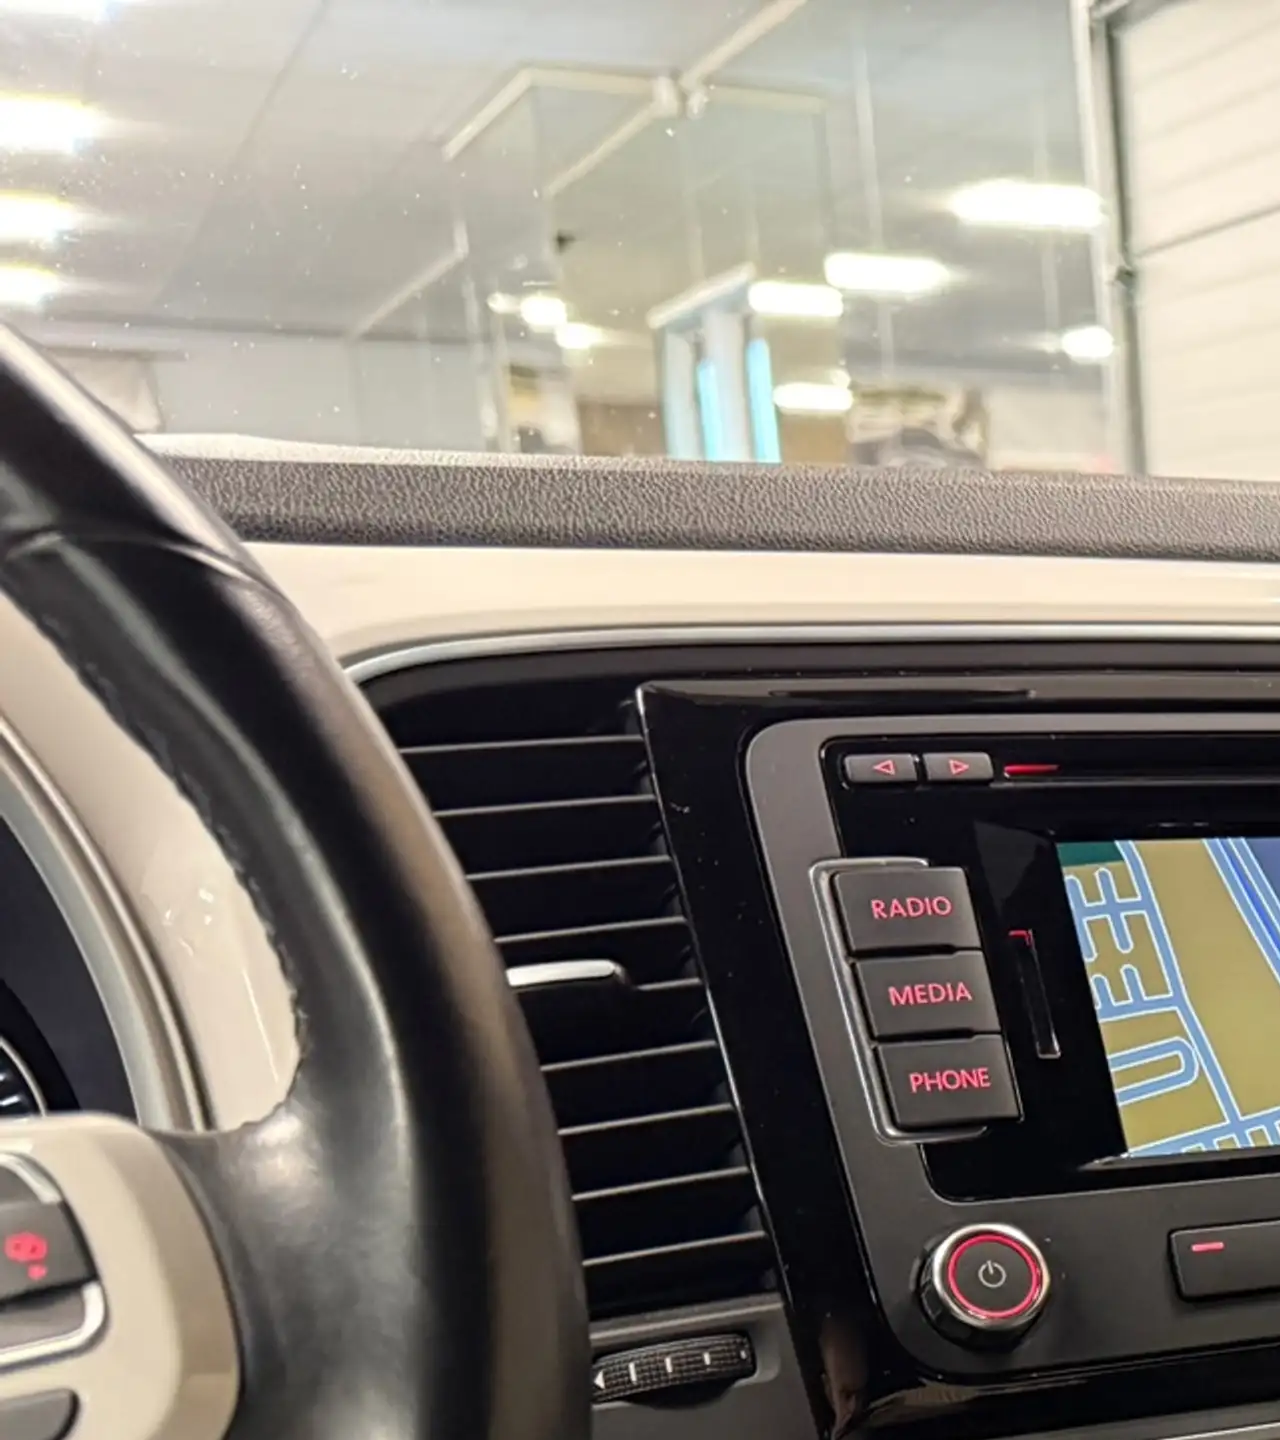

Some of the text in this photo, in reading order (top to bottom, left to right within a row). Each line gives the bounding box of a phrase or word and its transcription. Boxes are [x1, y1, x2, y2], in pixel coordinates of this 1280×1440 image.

[872, 896, 953, 918] RADIO
[889, 982, 972, 1006] MEDIA
[909, 1067, 991, 1092] PHONE
